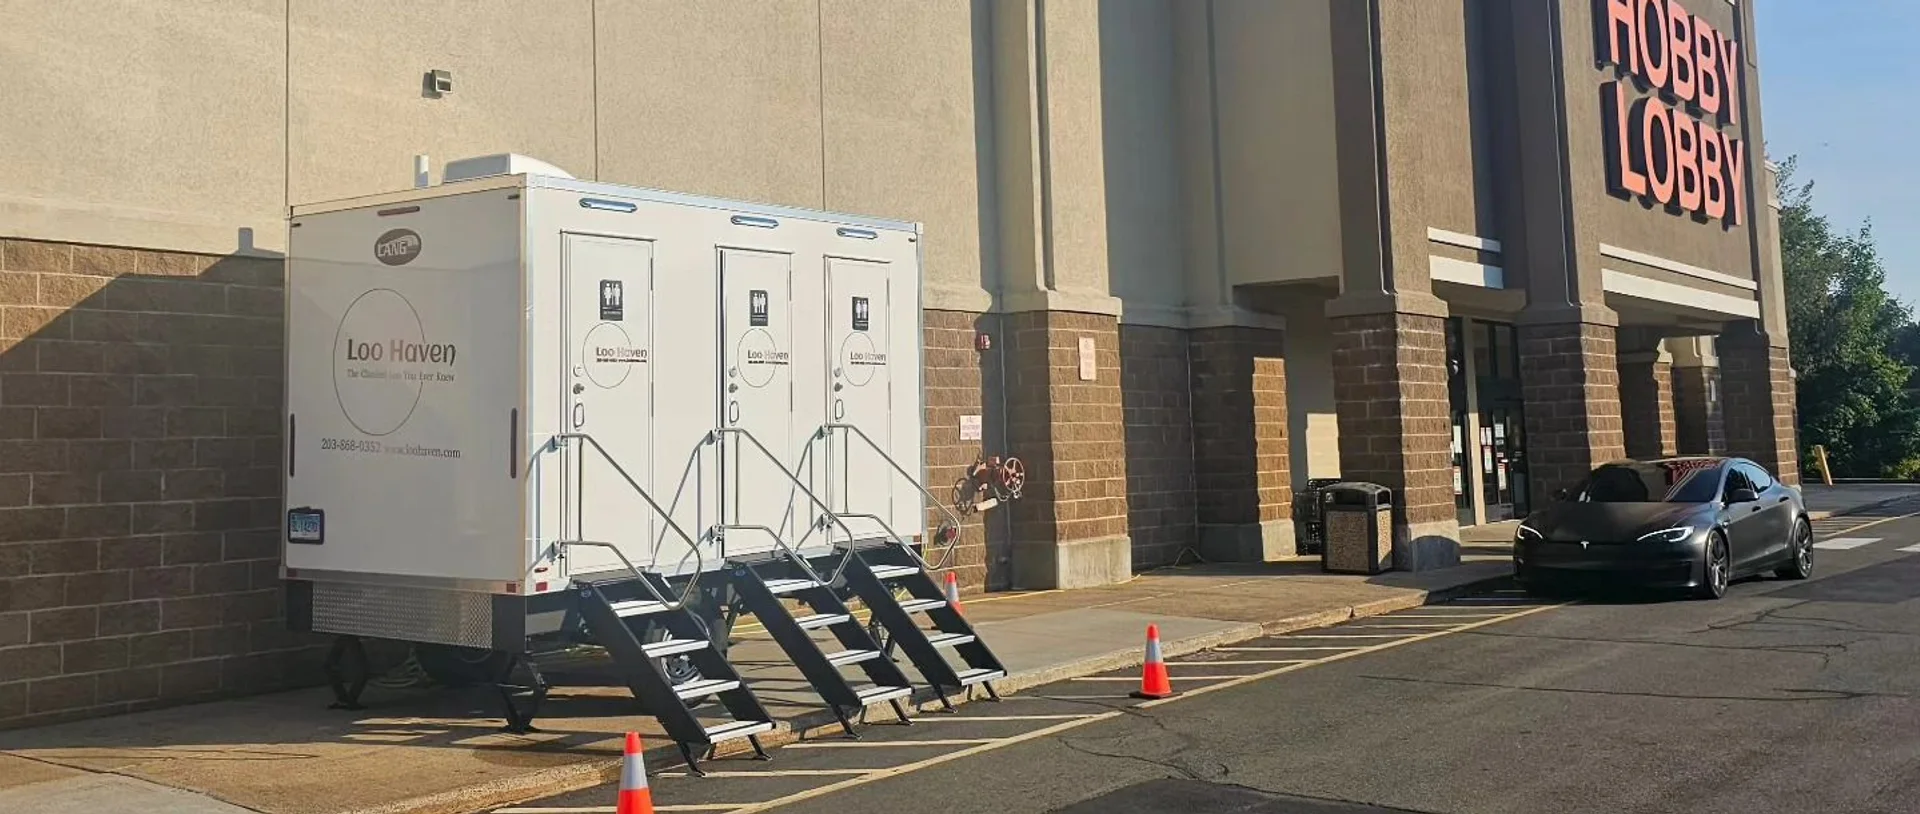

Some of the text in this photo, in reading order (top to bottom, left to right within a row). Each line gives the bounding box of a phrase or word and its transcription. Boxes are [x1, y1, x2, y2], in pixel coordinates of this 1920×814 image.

[1607, 0, 1738, 125] HOBBY
[1616, 80, 1744, 226] LOBBY
[377, 239, 407, 258] LANG
[347, 338, 456, 367] Loo Haven
[596, 346, 648, 358] Loo Haven
[747, 350, 789, 361] Loo Haven
[850, 351, 886, 362] Loo Haven
[321, 437, 382, 453] 203-868-0352
